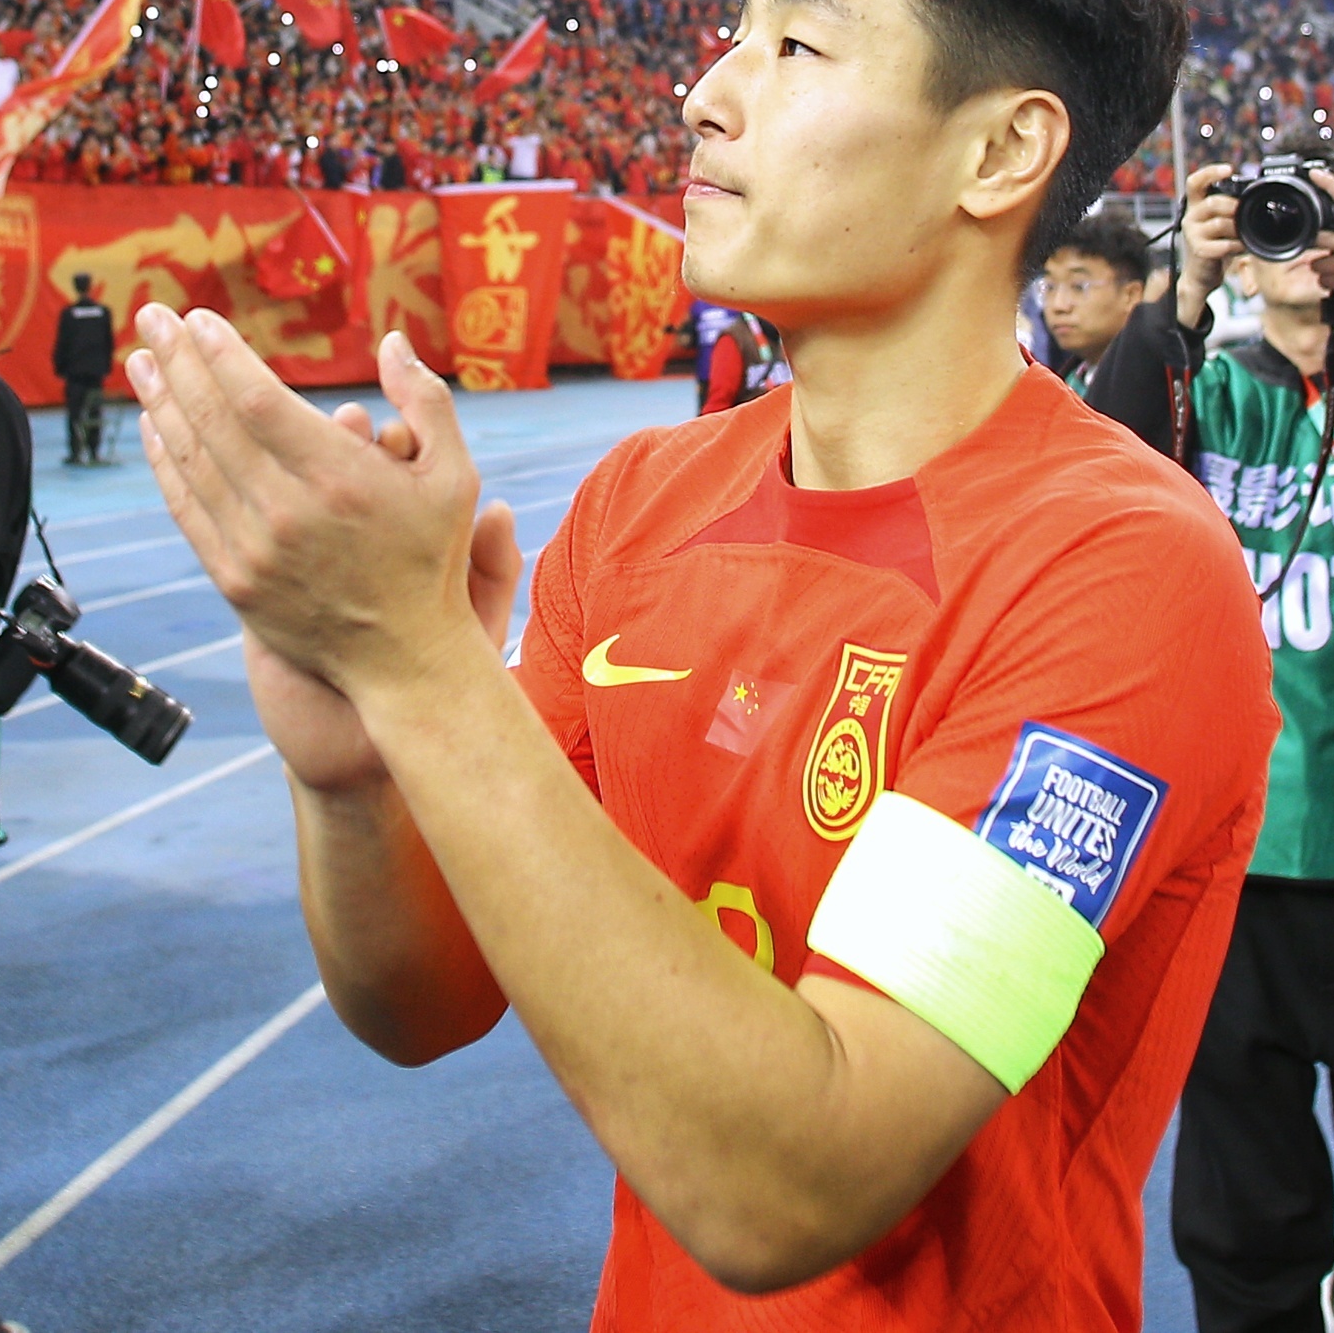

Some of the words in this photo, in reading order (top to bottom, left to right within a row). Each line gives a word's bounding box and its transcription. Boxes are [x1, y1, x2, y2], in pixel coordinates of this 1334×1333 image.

[844, 659, 902, 697] CFA
[1026, 788, 1117, 863] UNITES
[1042, 763, 1128, 826] FOOTBALL
[1007, 819, 1048, 858] the
[1045, 835, 1113, 896] World
